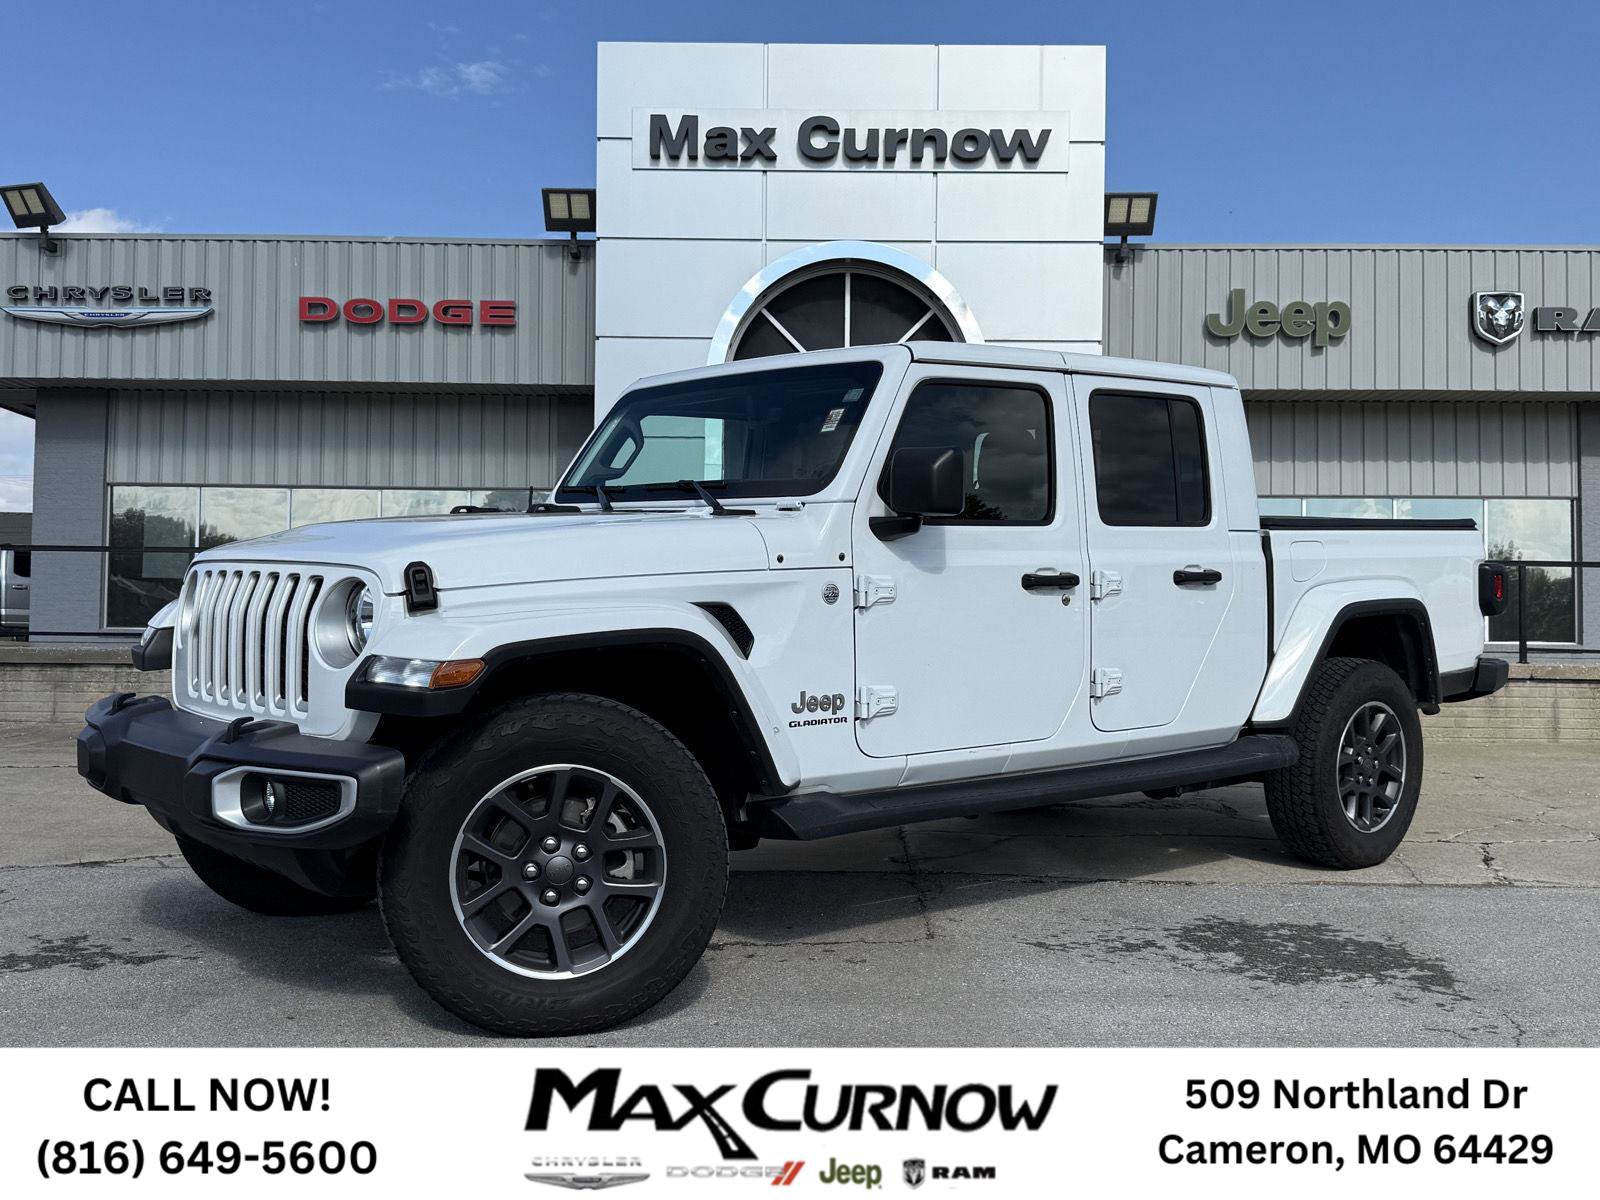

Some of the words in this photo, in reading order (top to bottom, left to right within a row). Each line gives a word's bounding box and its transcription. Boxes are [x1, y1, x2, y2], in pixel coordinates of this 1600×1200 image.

[650, 114, 777, 161] Max
[798, 115, 1052, 164] Curnow
[7, 285, 213, 301] CHRYSLER
[299, 296, 517, 326] DODGE
[1205, 288, 1352, 347] Jeep
[791, 690, 845, 715] Jeep
[789, 717, 848, 728] GLADIATOR
